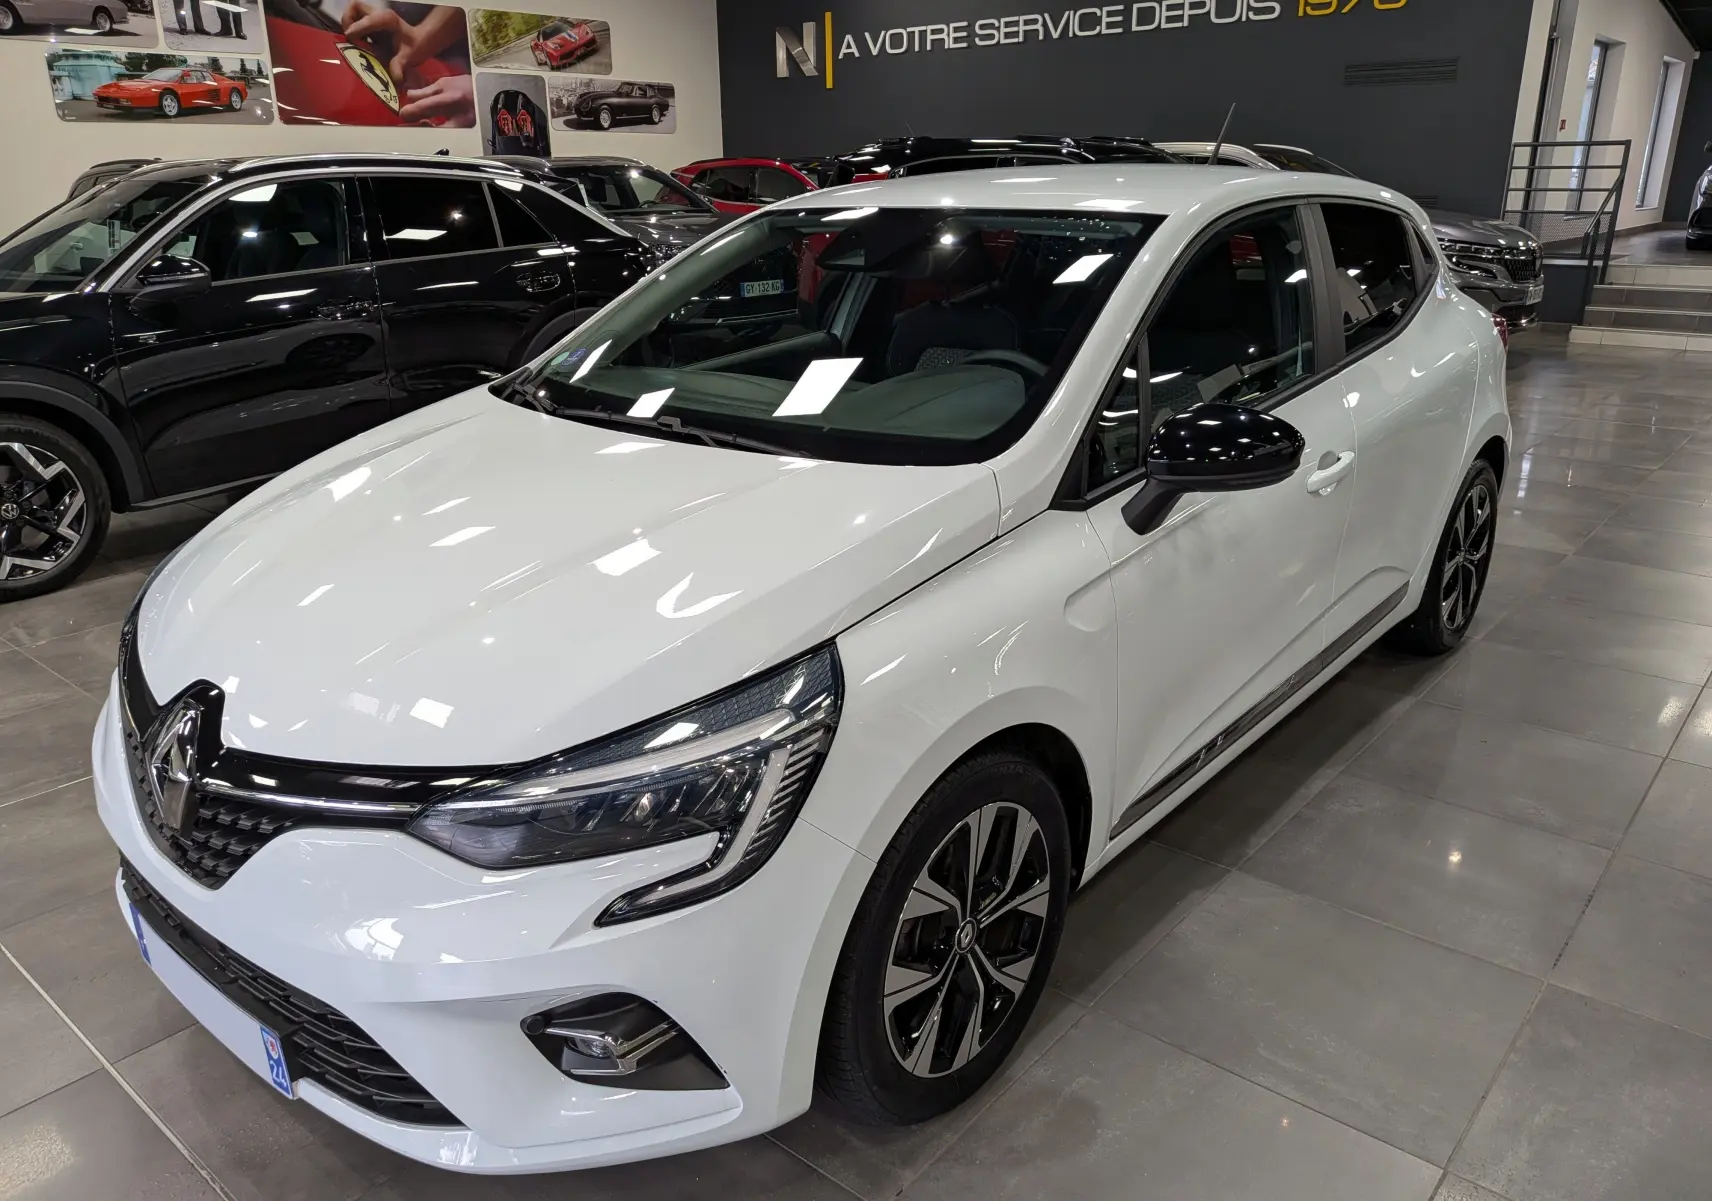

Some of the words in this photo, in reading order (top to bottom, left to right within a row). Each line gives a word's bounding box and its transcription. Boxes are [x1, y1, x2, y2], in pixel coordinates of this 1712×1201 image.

[838, 34, 860, 59] A
[864, 21, 969, 56] VOTRE
[974, 5, 1124, 46] SERVICE
[1131, 0, 1282, 32] DEPUIS
